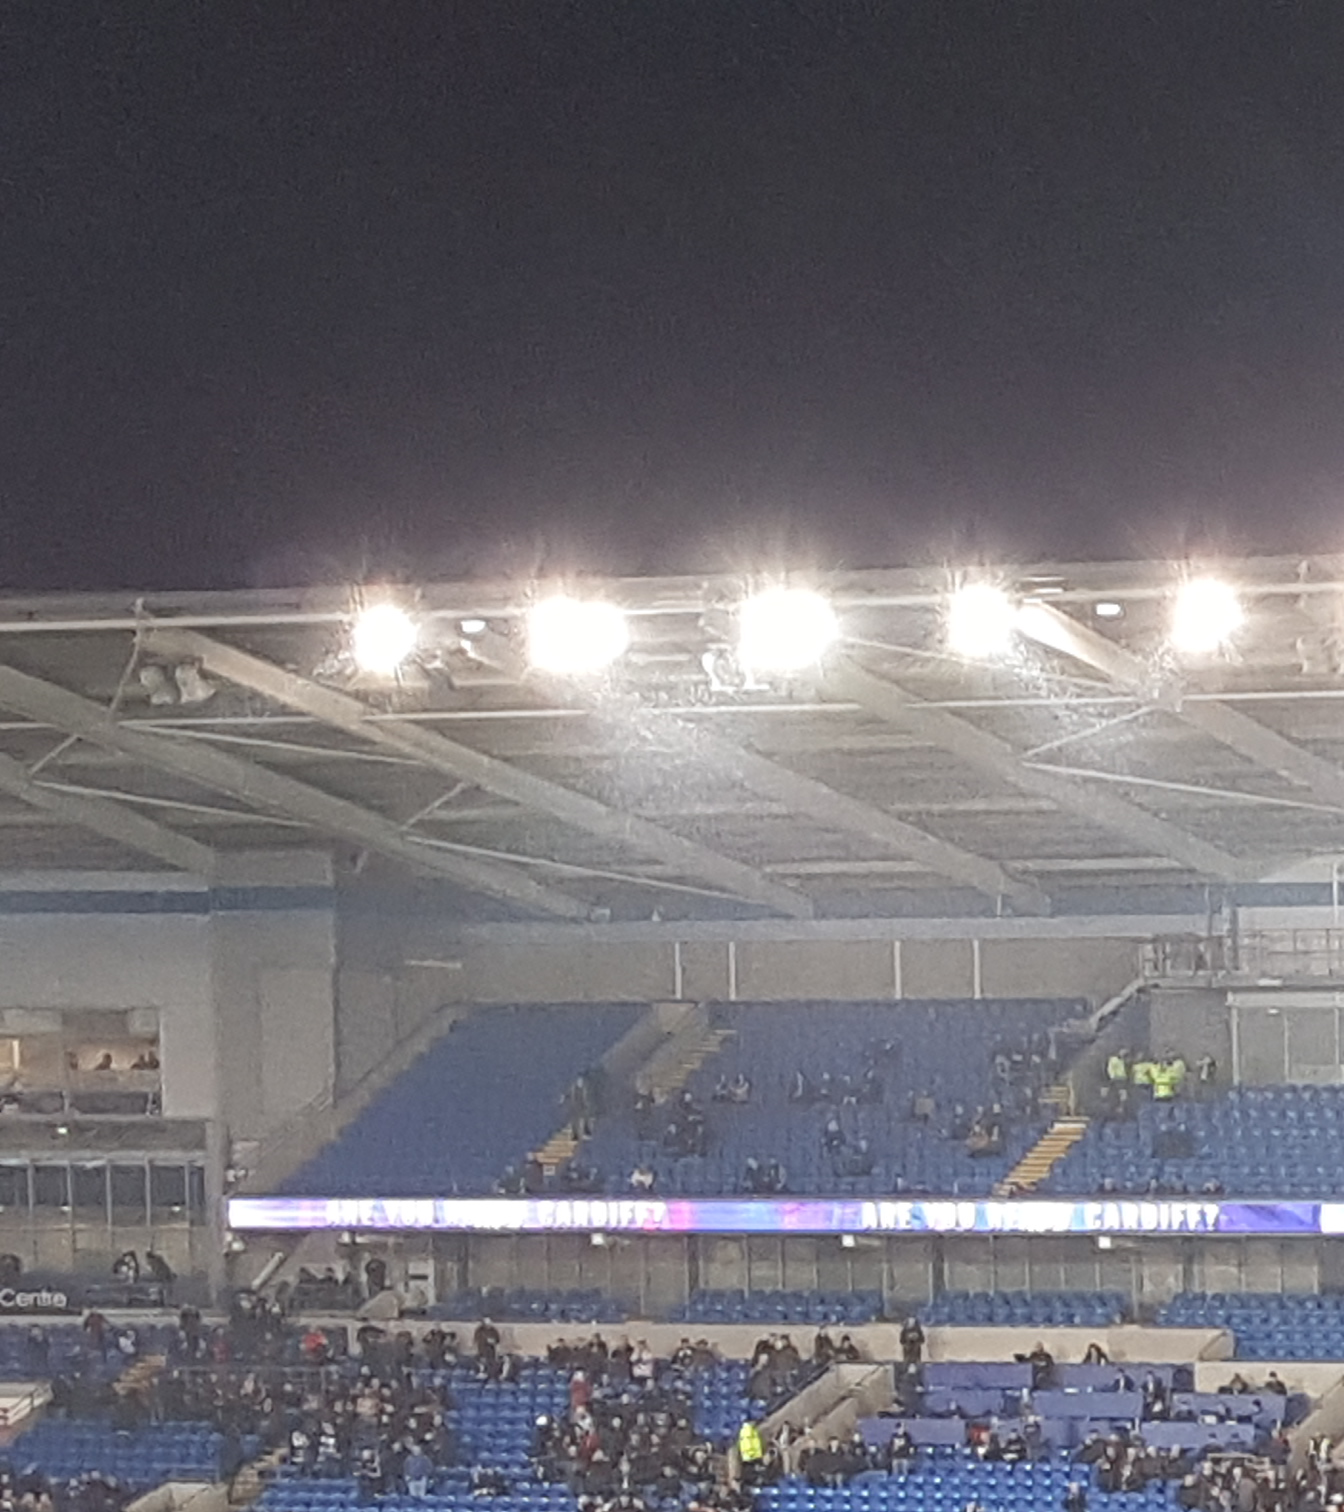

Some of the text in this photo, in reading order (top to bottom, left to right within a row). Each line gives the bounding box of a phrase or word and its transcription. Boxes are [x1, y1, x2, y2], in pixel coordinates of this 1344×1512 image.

[327, 1201, 373, 1226] ARE
[385, 1201, 434, 1226] YOU
[537, 1201, 666, 1226] CARDIFF?
[862, 1202, 915, 1230] ARE
[925, 1202, 975, 1230] YOU
[1085, 1202, 1219, 1230] CARDIFF?
